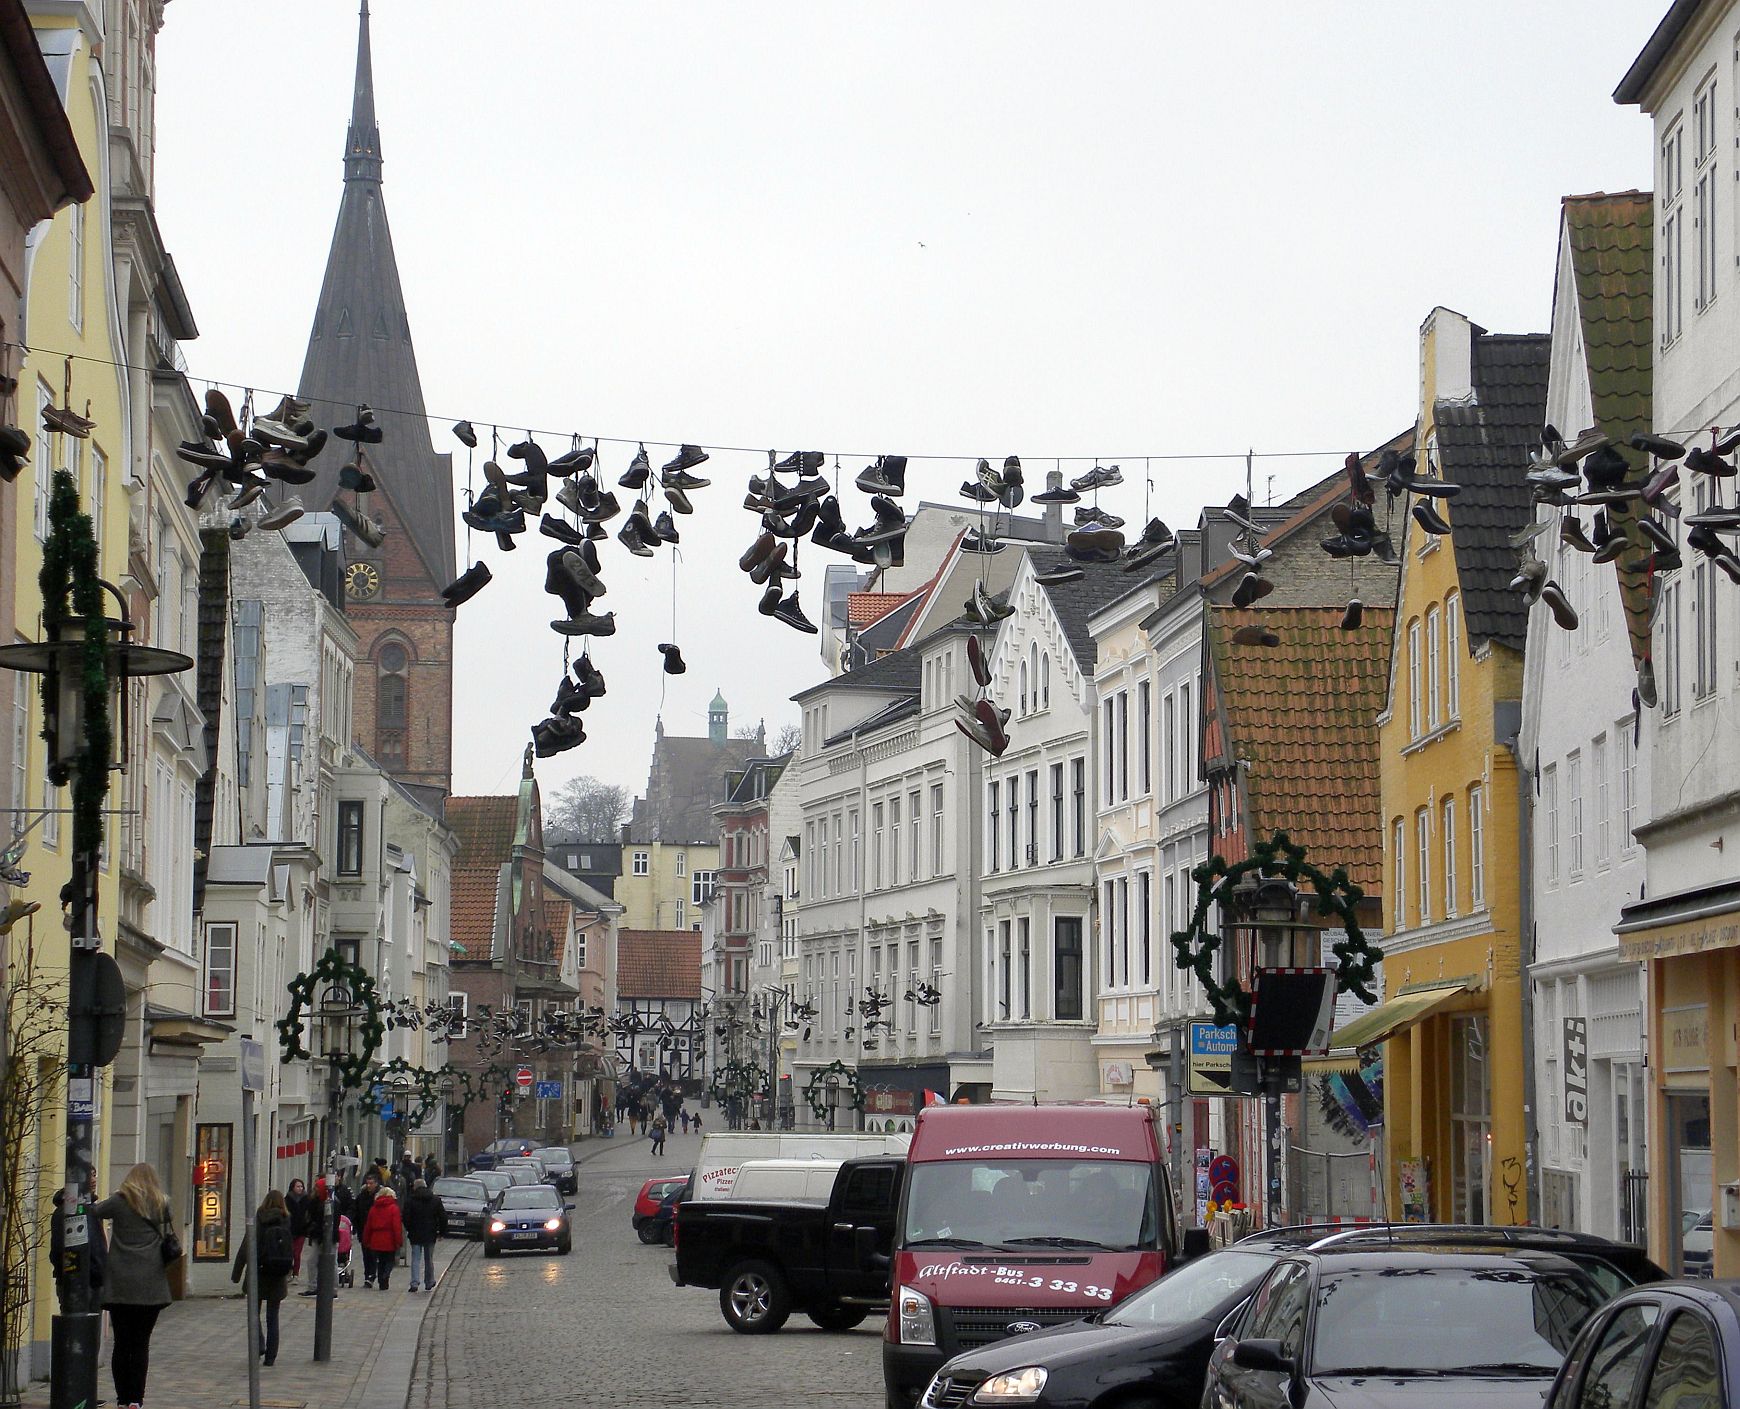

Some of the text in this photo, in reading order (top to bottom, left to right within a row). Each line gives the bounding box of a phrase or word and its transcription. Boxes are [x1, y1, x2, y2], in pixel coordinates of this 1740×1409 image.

[1199, 1027, 1237, 1039] Parksch
[945, 1142, 1120, 1156] www.creativwerbung.com
[702, 1167, 740, 1183] Pizzatec
[1048, 1279, 1078, 1293] 33
[1083, 1285, 1113, 1301] 33
